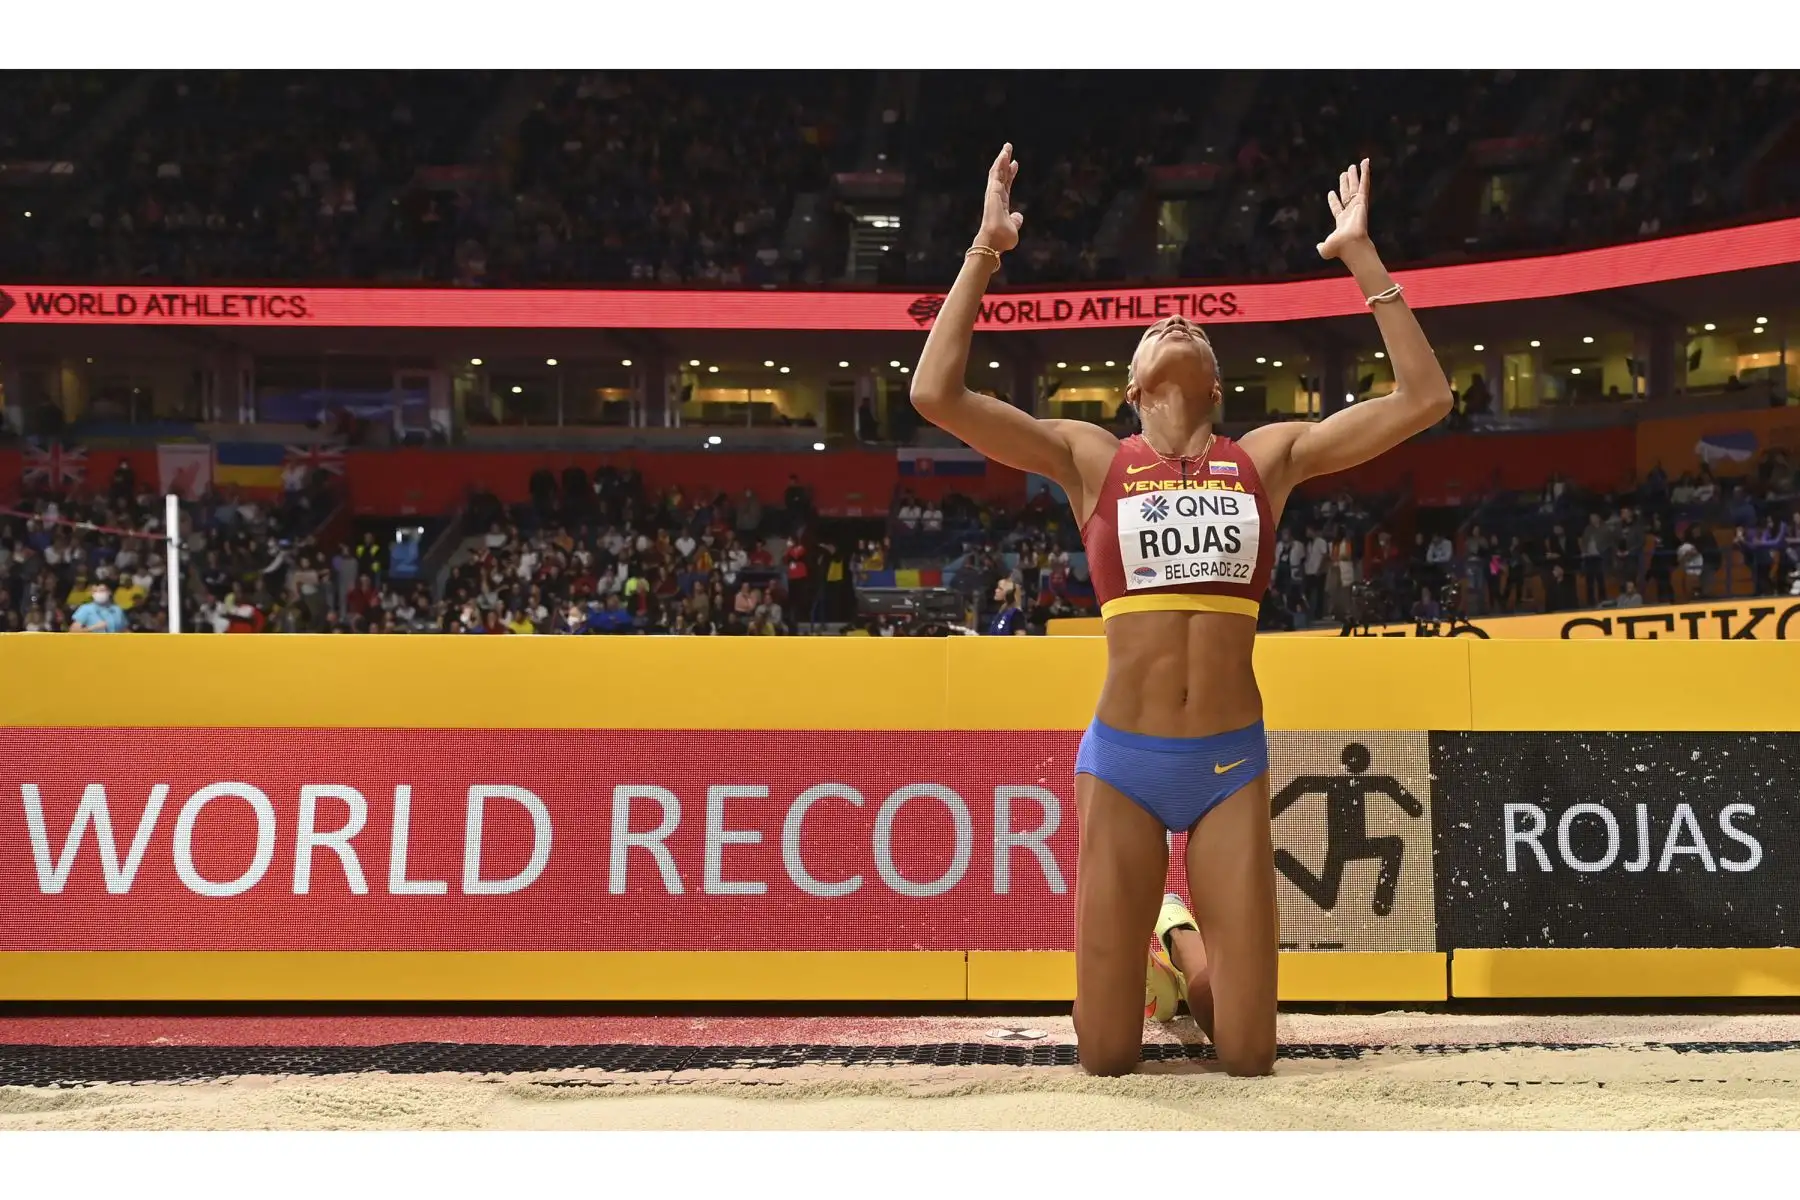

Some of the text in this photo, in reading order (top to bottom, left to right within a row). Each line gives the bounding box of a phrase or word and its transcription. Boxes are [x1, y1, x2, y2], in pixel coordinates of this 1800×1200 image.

[25, 292, 137, 316] WORLD
[1123, 479, 1246, 493] VENEZUELA
[1175, 495, 1240, 518] QNB
[1139, 525, 1242, 559] ROJAS
[1165, 561, 1250, 581] BELGRADE 22
[20, 781, 554, 897] WORLD
[1503, 803, 1763, 872] ROJAS
